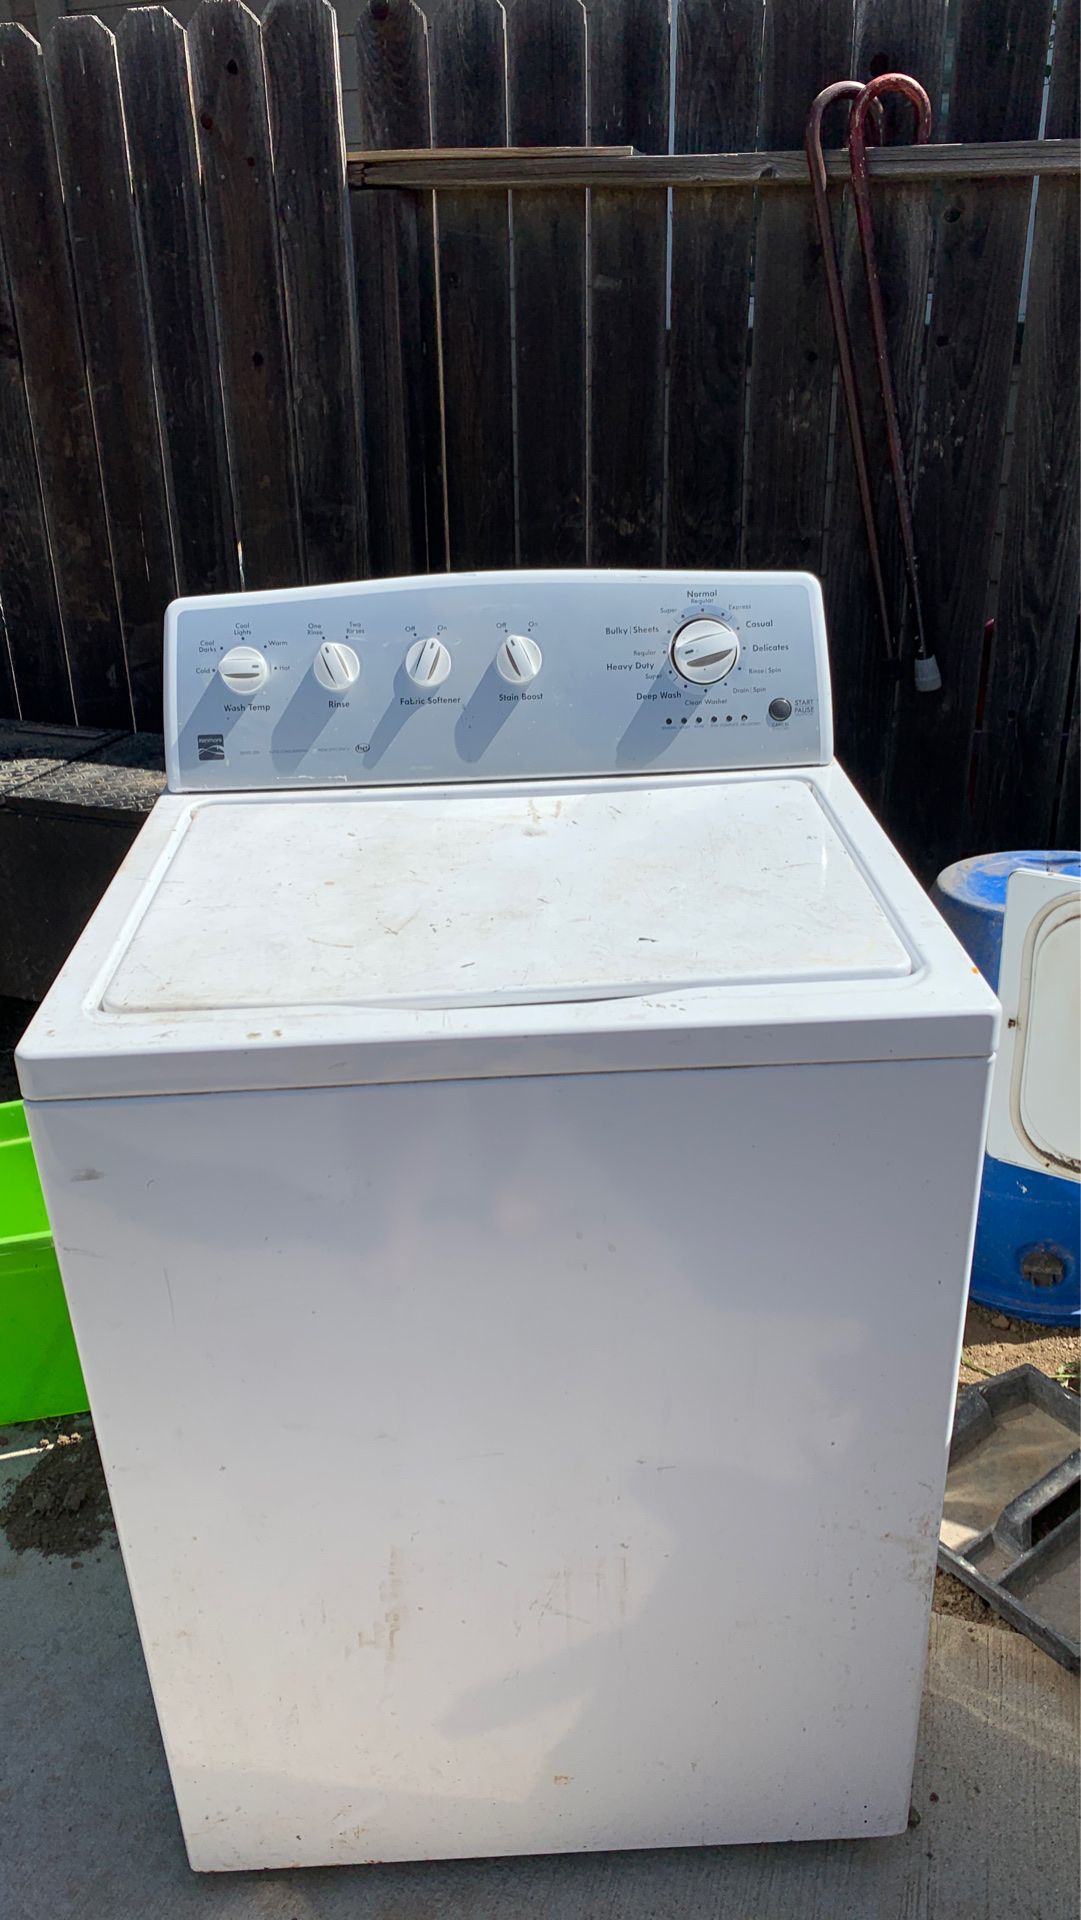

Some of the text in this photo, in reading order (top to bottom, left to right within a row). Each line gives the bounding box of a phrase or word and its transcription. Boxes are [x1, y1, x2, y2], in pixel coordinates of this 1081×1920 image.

[686, 589, 718, 598] Normal
[728, 603, 752, 611] Express
[745, 619, 774, 629] Casual
[605, 625, 660, 635] Bulky Sheets
[752, 644, 789, 653] Delicates
[606, 662, 655, 671] Heavy Duty
[400, 695, 461, 705] Fabric Softener
[499, 692, 543, 702] Stain Boost
[636, 691, 682, 701] Deep Wash
[223, 703, 271, 712] Wash Temp
[328, 700, 350, 708] Rinse
